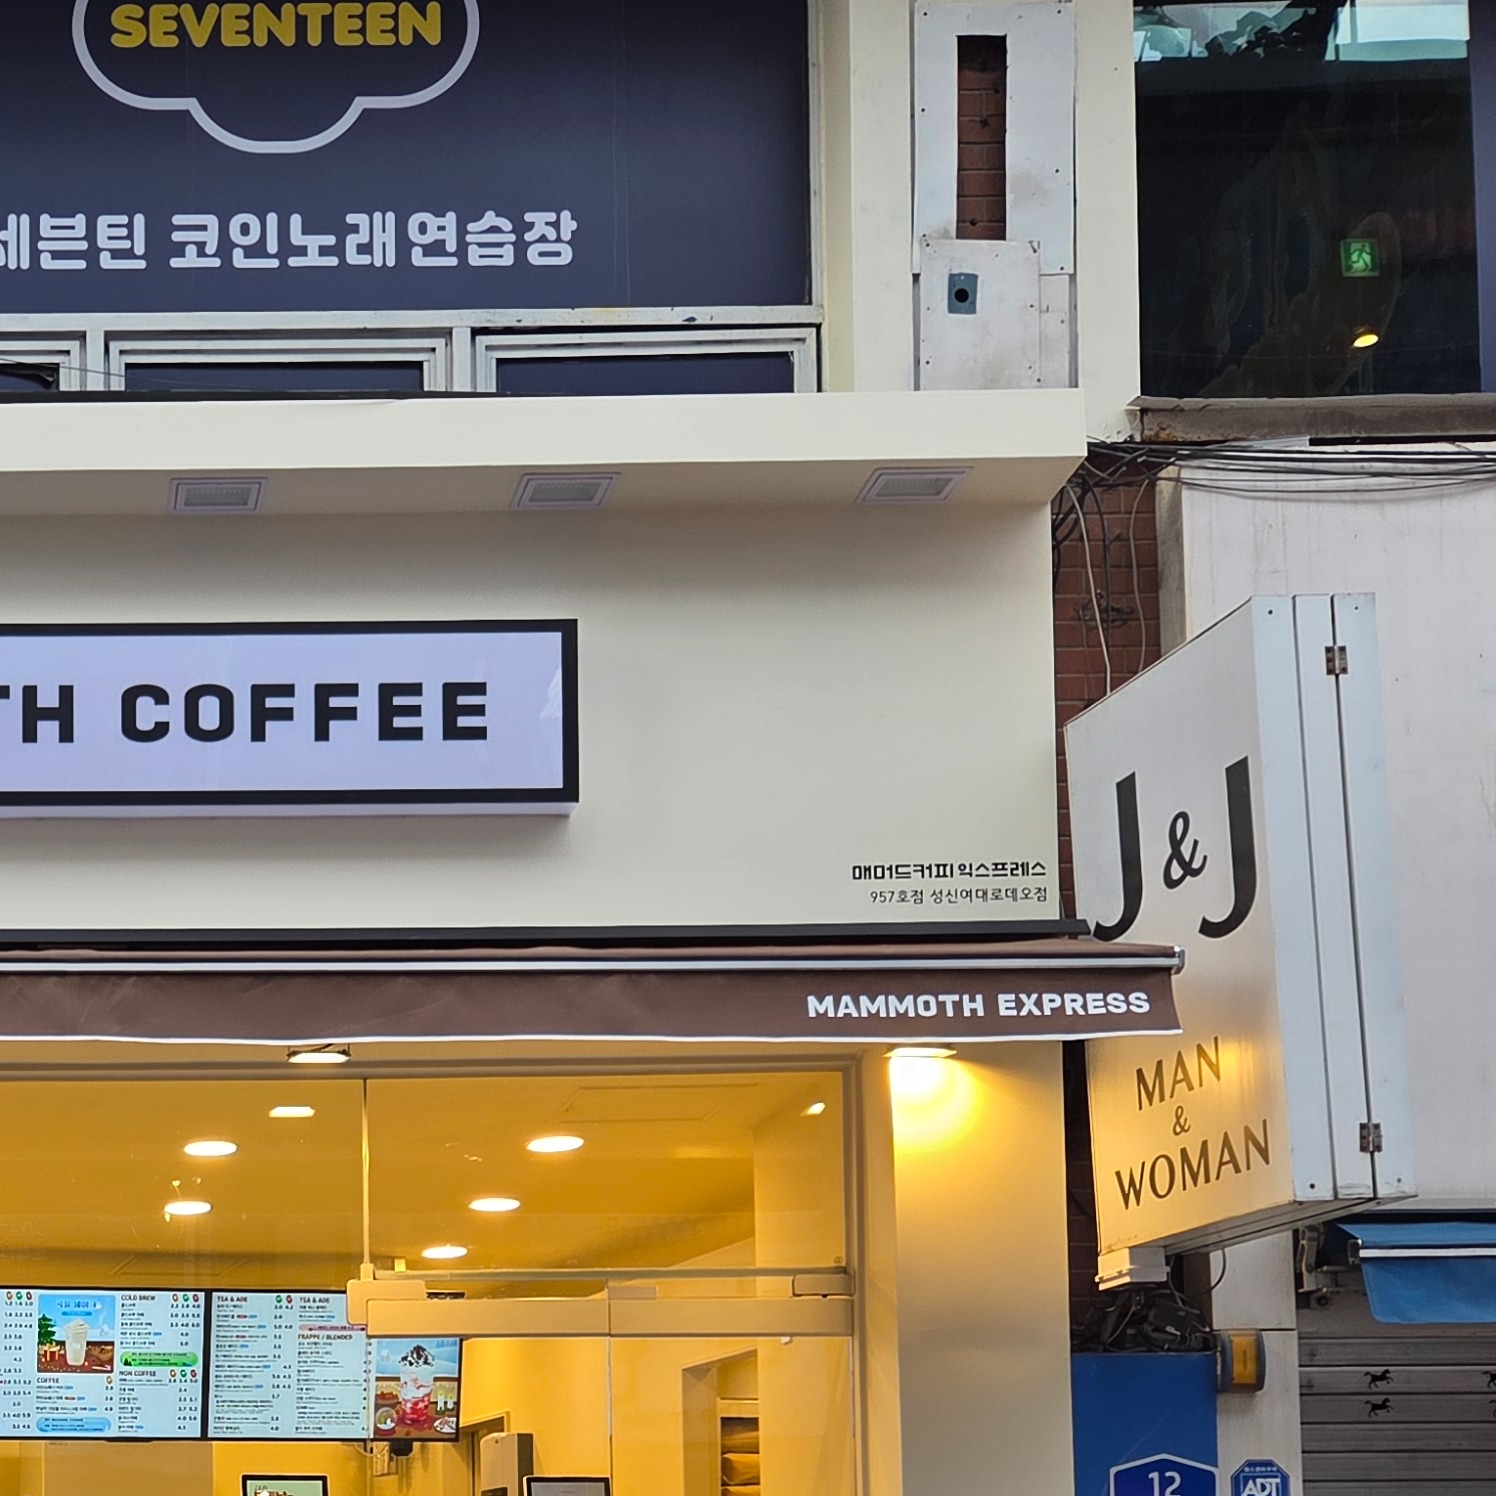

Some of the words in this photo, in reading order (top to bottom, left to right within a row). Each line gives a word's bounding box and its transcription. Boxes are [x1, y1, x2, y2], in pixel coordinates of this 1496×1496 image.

[110, 2, 442, 48] SEVENTEEN
[169, 210, 577, 269] 코인노래연습장
[119, 681, 489, 742] COFFEE
[852, 863, 954, 881] 매머드커피
[958, 861, 1047, 878] 익스프레스
[870, 888, 924, 904] 957호점
[930, 886, 1048, 903] 성신여대로데오점
[807, 994, 985, 1018] MAMMOTH
[998, 992, 1150, 1016] EXPRESS
[1135, 1035, 1222, 1111] MAN
[1171, 1104, 1192, 1137] &
[1115, 1119, 1271, 1210] WOMAN
[1241, 1478, 1280, 1496] ADT
